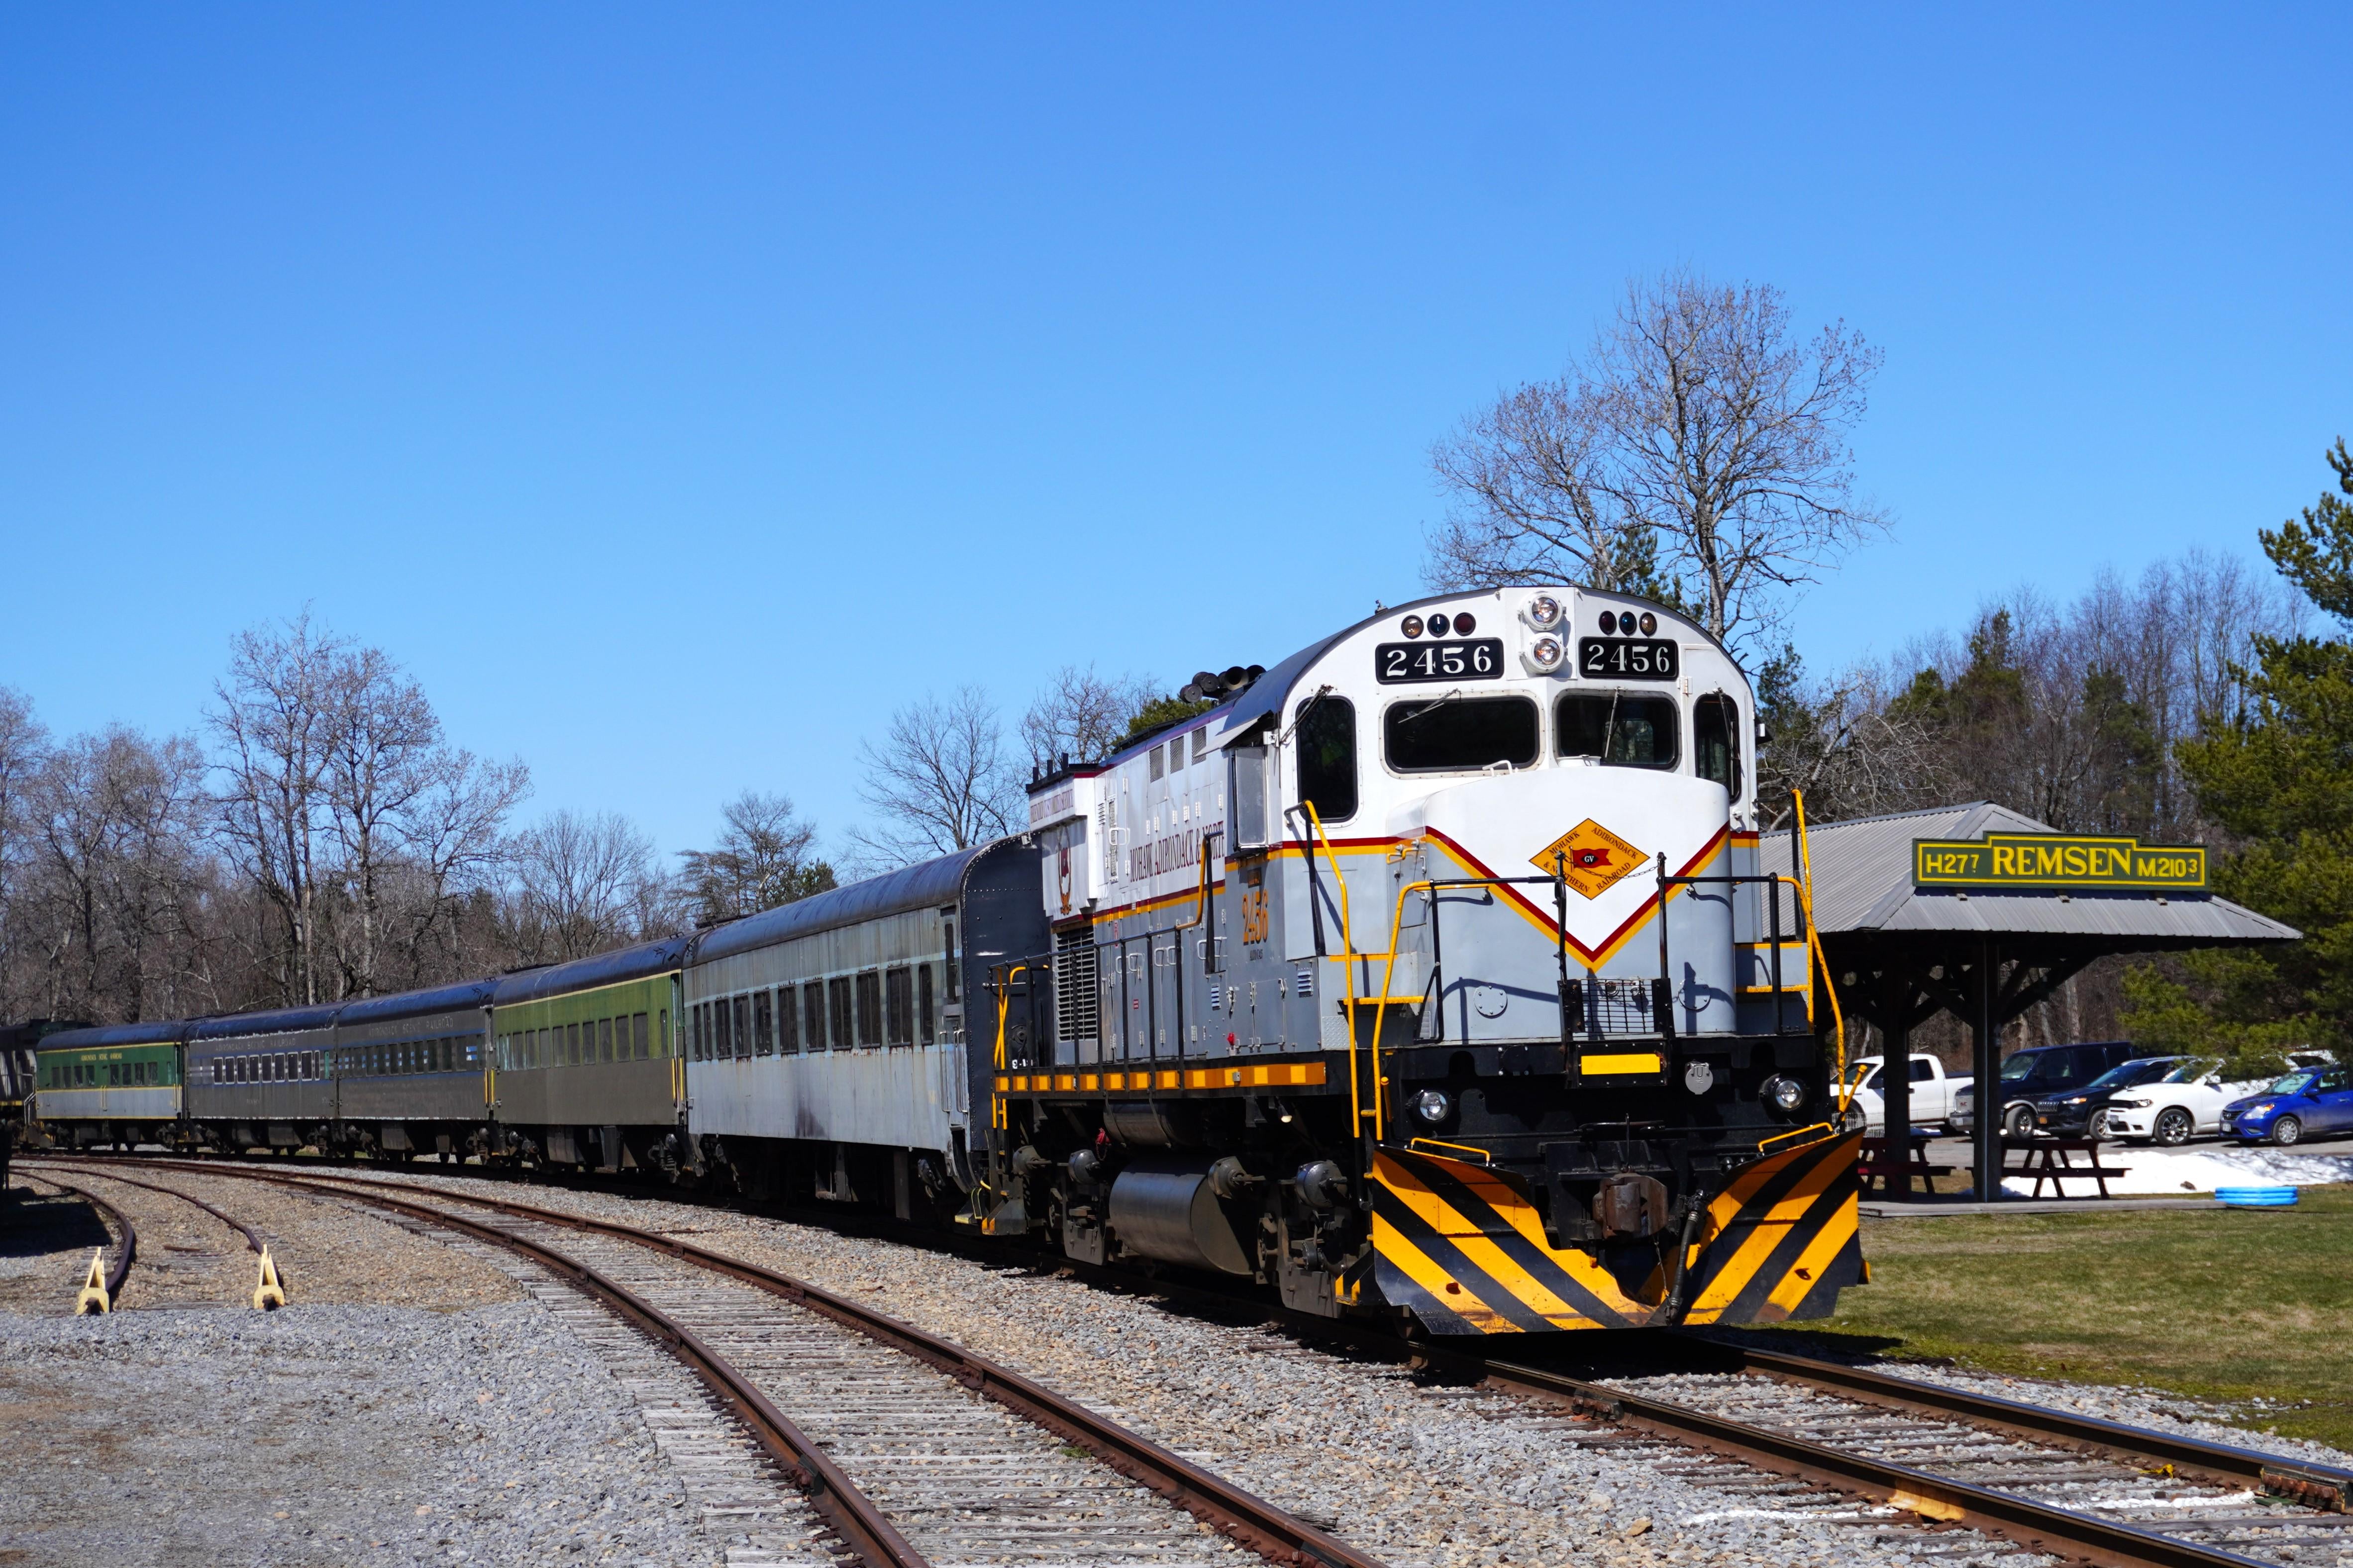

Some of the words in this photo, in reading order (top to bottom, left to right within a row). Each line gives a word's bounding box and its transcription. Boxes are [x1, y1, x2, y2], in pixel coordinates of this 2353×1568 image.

[1387, 646, 1492, 677] 2456
[1588, 645, 1669, 672] 2456
[1130, 842, 1153, 882] MOHAWK
[1154, 829, 1194, 876] ADIRONDACK
[1196, 828, 1201, 865] &
[1548, 831, 1580, 856] MOHAWK
[1591, 827, 1638, 860] ADIRONDACK
[1596, 862, 1631, 890] RAILROAD
[1991, 846, 2132, 876] REMSEN
[1551, 866, 1590, 893] NTHERN
[1242, 889, 1268, 946] 2456
